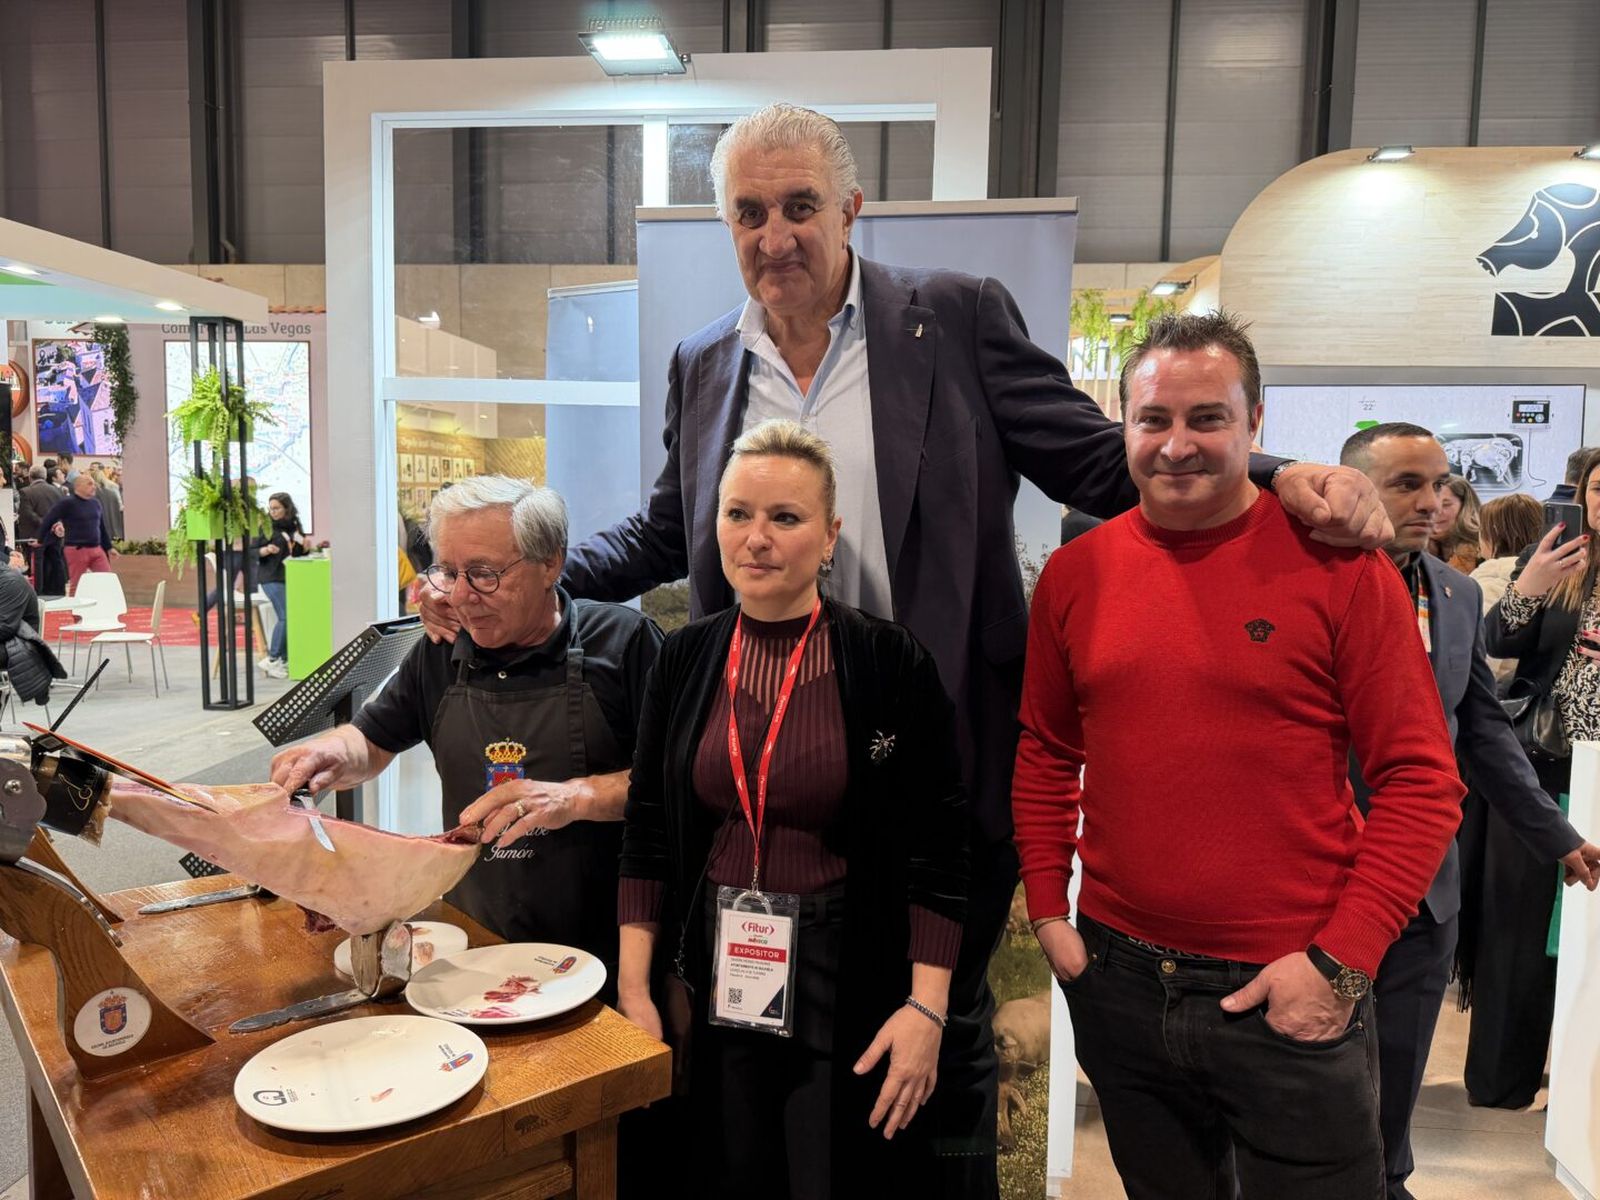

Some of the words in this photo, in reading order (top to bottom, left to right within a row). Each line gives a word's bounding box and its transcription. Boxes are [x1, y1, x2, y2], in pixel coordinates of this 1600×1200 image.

[270, 322, 311, 337] Vegas
[484, 843, 535, 862] Jamón
[748, 922, 769, 934] Fitur
[734, 947, 780, 959] EXPOSITOR
